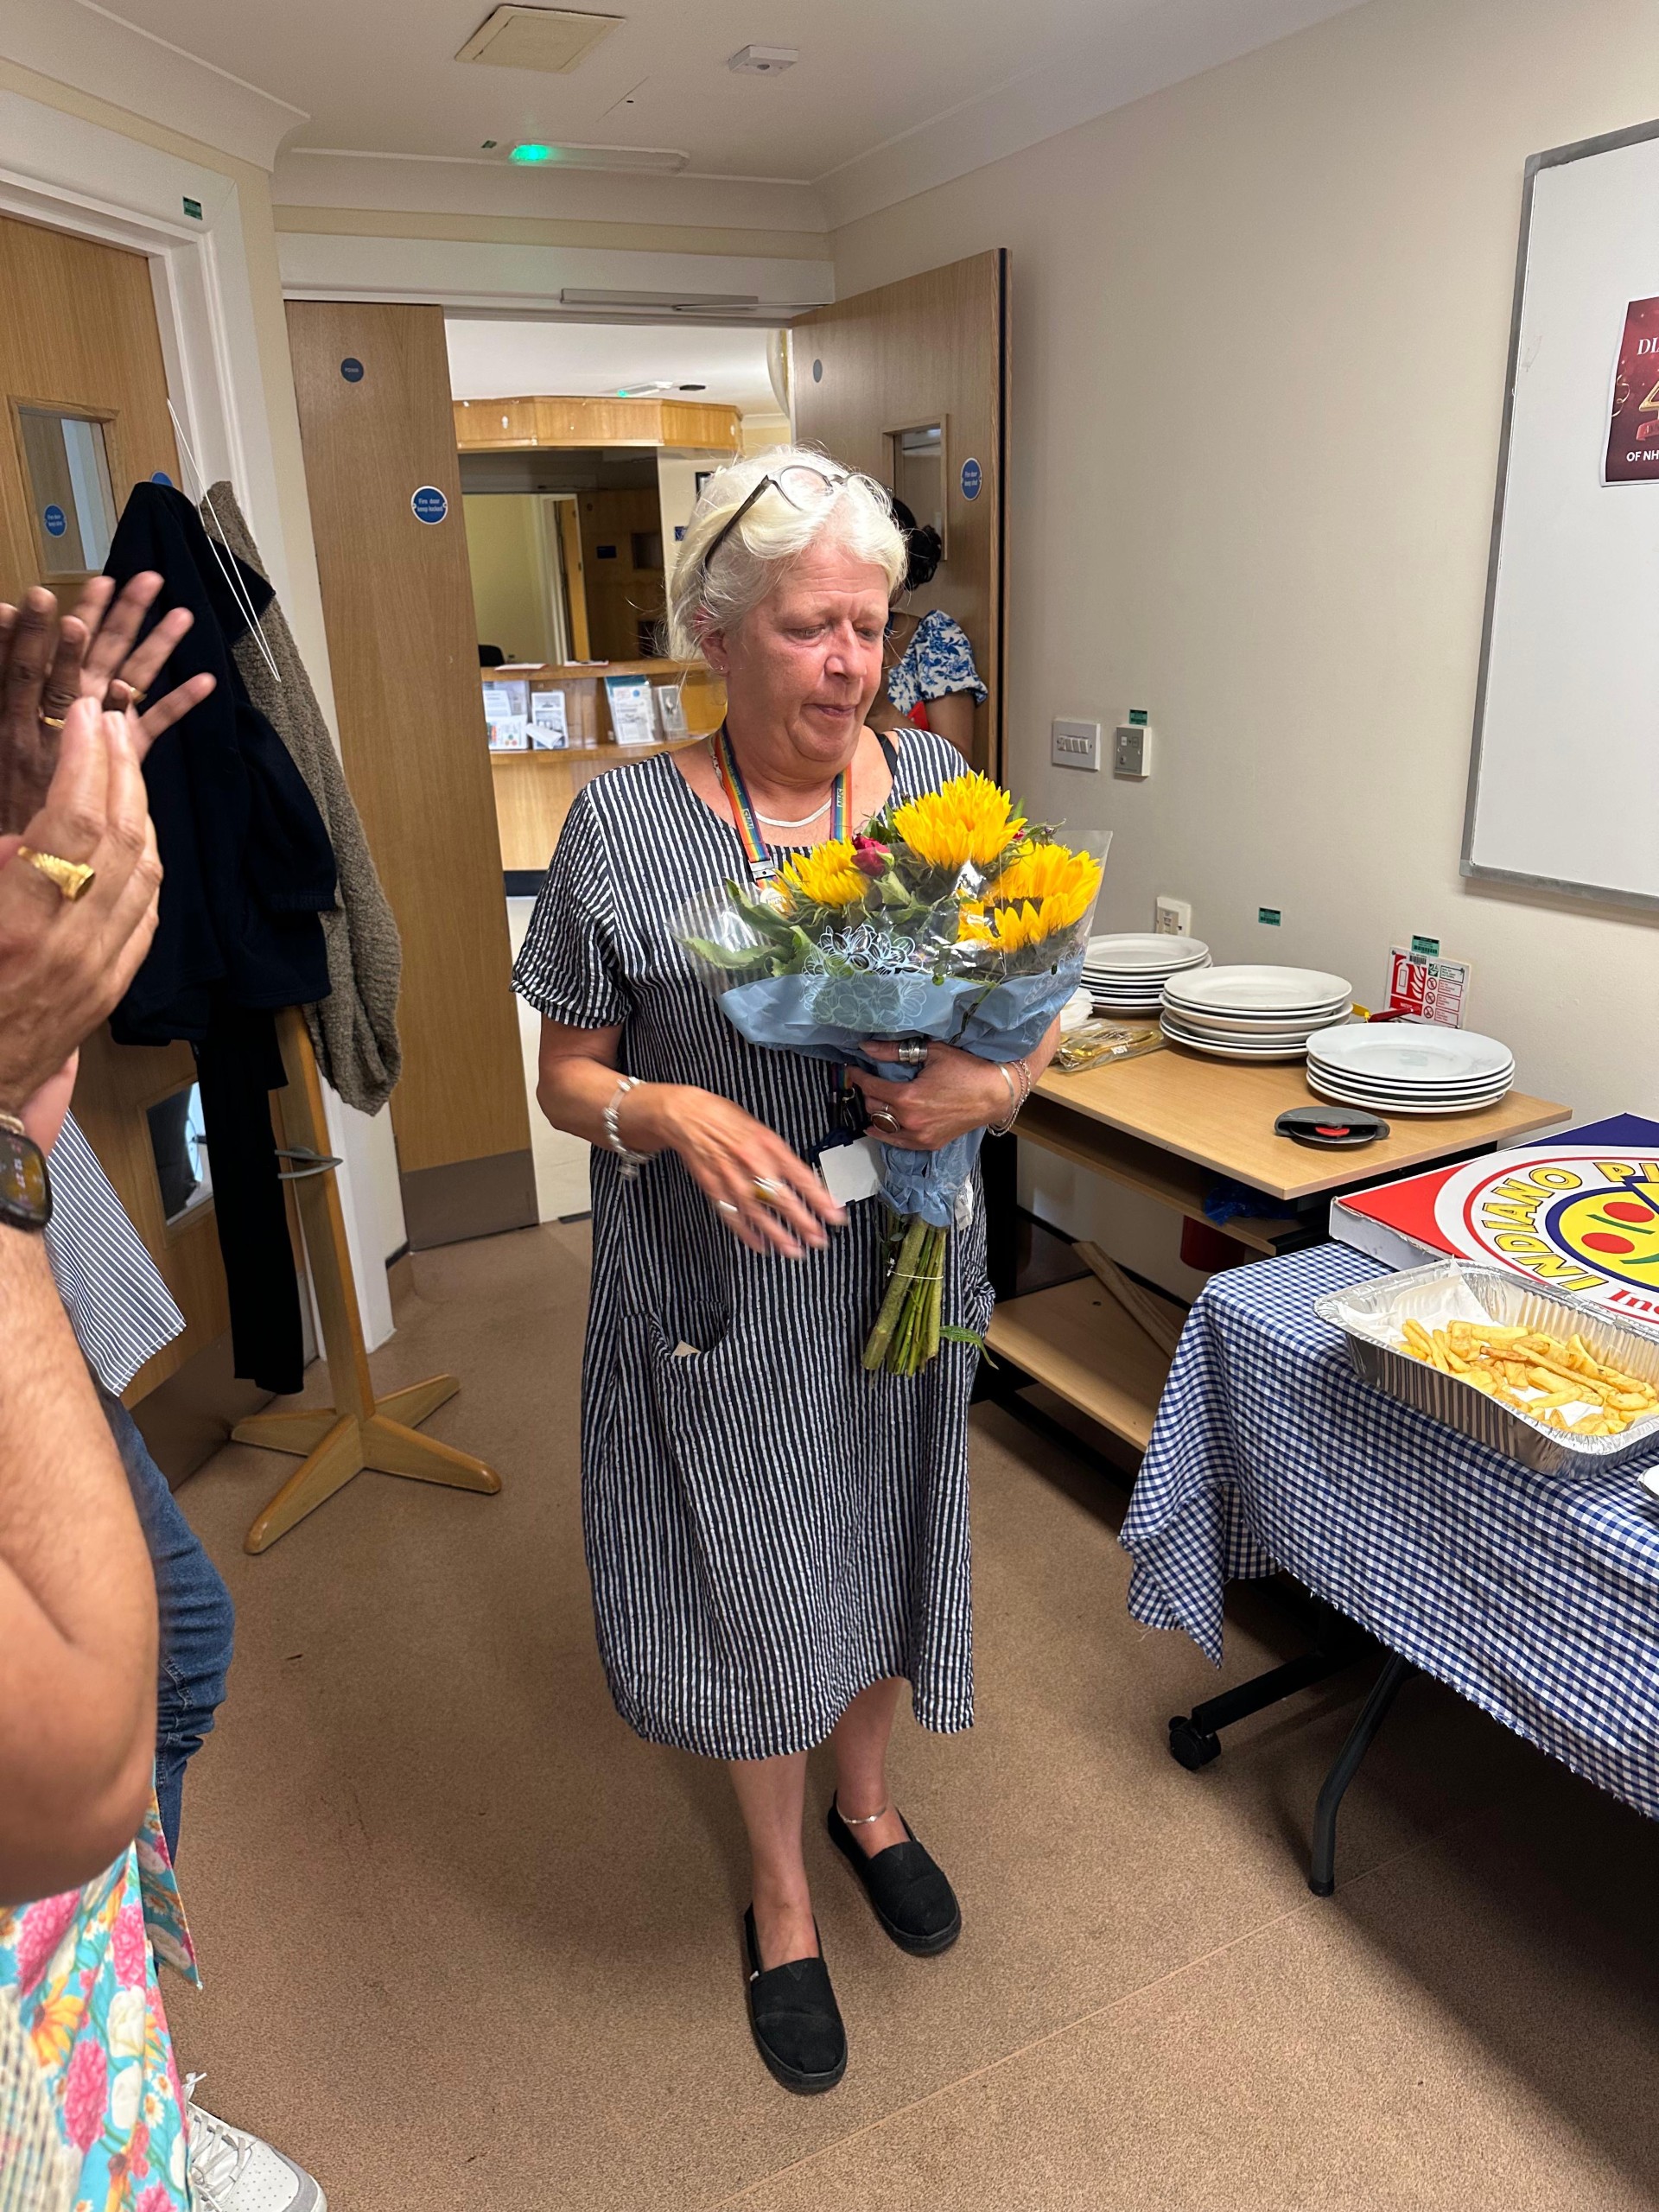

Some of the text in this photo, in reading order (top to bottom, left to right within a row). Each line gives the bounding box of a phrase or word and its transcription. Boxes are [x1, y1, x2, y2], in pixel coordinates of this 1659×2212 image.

[1637, 336, 1659, 355] DI
[1626, 451, 1642, 462] OF
[743, 808, 754, 830] NHS
[1481, 1166, 1609, 1292] INDIANO
